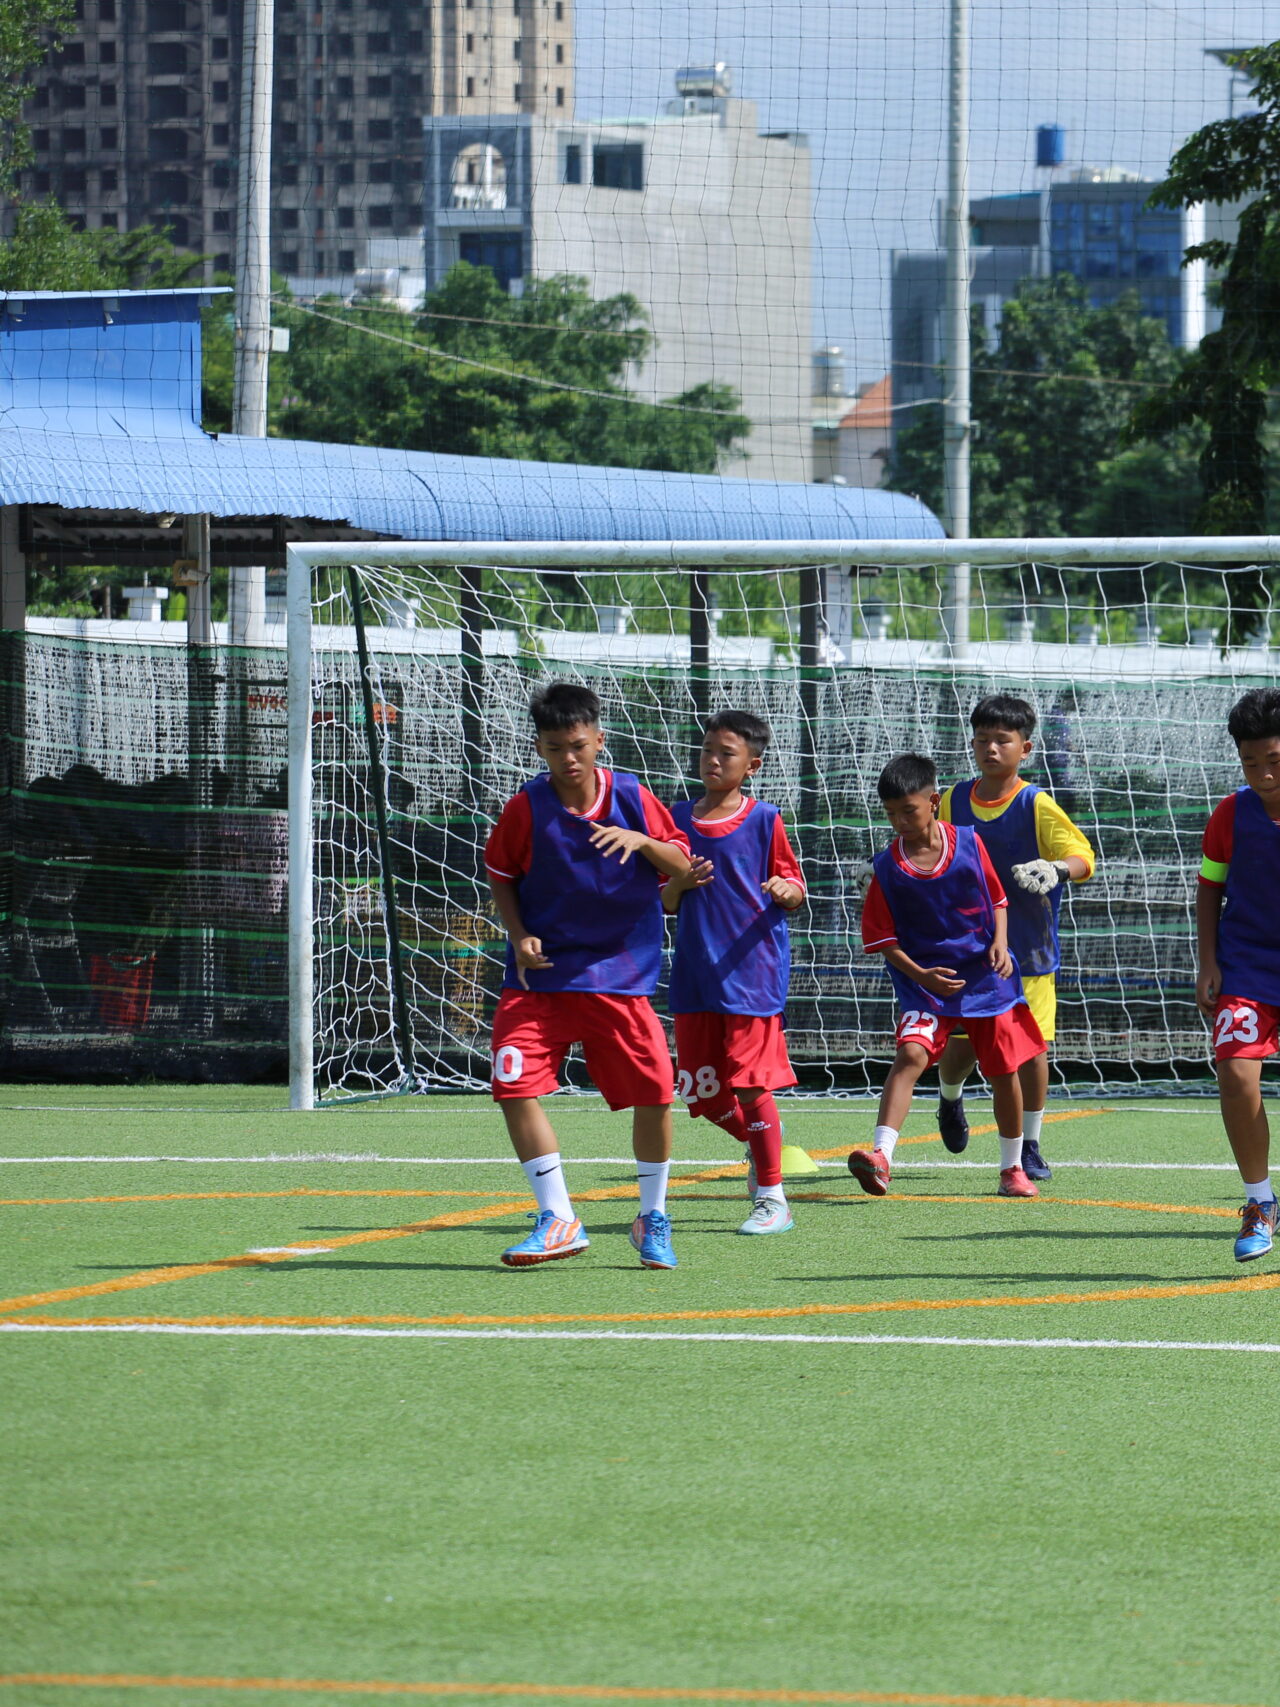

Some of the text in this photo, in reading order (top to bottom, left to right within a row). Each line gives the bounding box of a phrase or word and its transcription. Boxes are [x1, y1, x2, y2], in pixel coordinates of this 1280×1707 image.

[1215, 1006, 1259, 1047] 23
[491, 1045, 523, 1083] 0
[678, 1065, 721, 1105] 28
